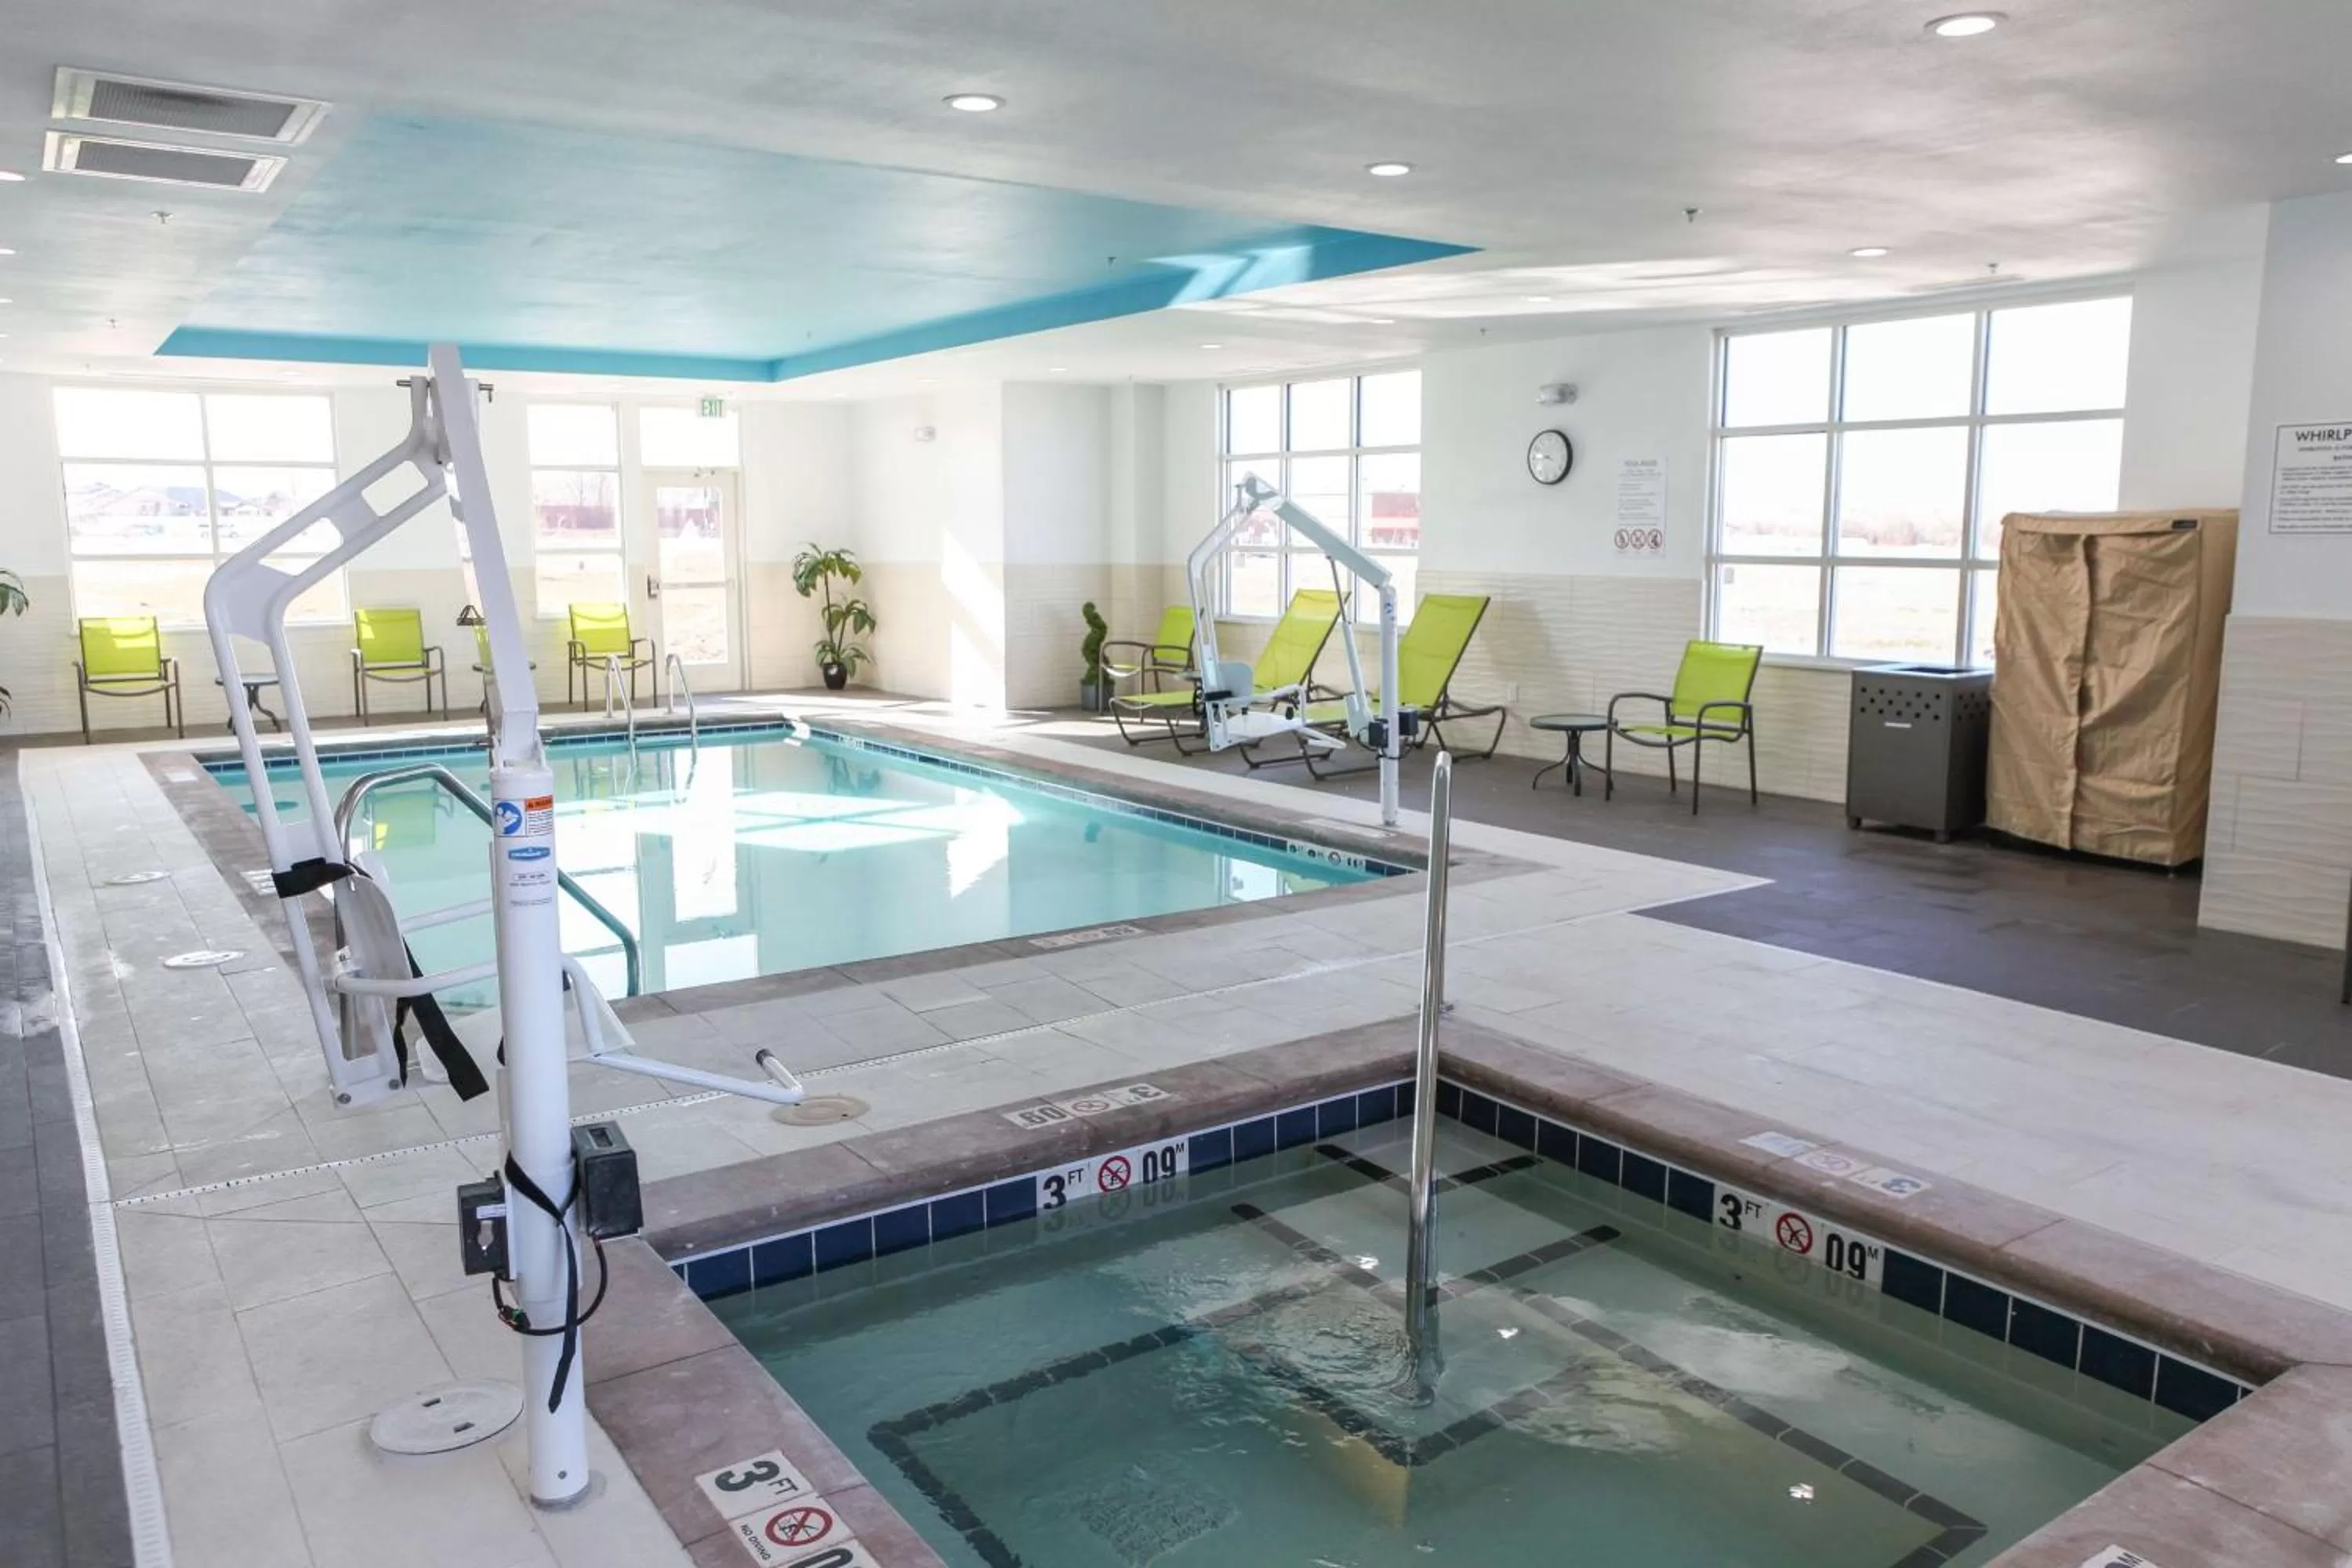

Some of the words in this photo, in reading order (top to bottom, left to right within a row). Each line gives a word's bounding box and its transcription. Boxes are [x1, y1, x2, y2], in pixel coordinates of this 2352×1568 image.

[702, 400, 723, 417] EXIT
[1043, 1174, 1067, 1209] 3
[1069, 1168, 1083, 1185] FT
[1719, 1194, 1742, 1230] 3
[1745, 1200, 1762, 1218] FT
[715, 1461, 780, 1492] 3
[768, 1478, 799, 1495] FT
[740, 1524, 753, 1536] NO
[749, 1535, 771, 1560] DIVING
